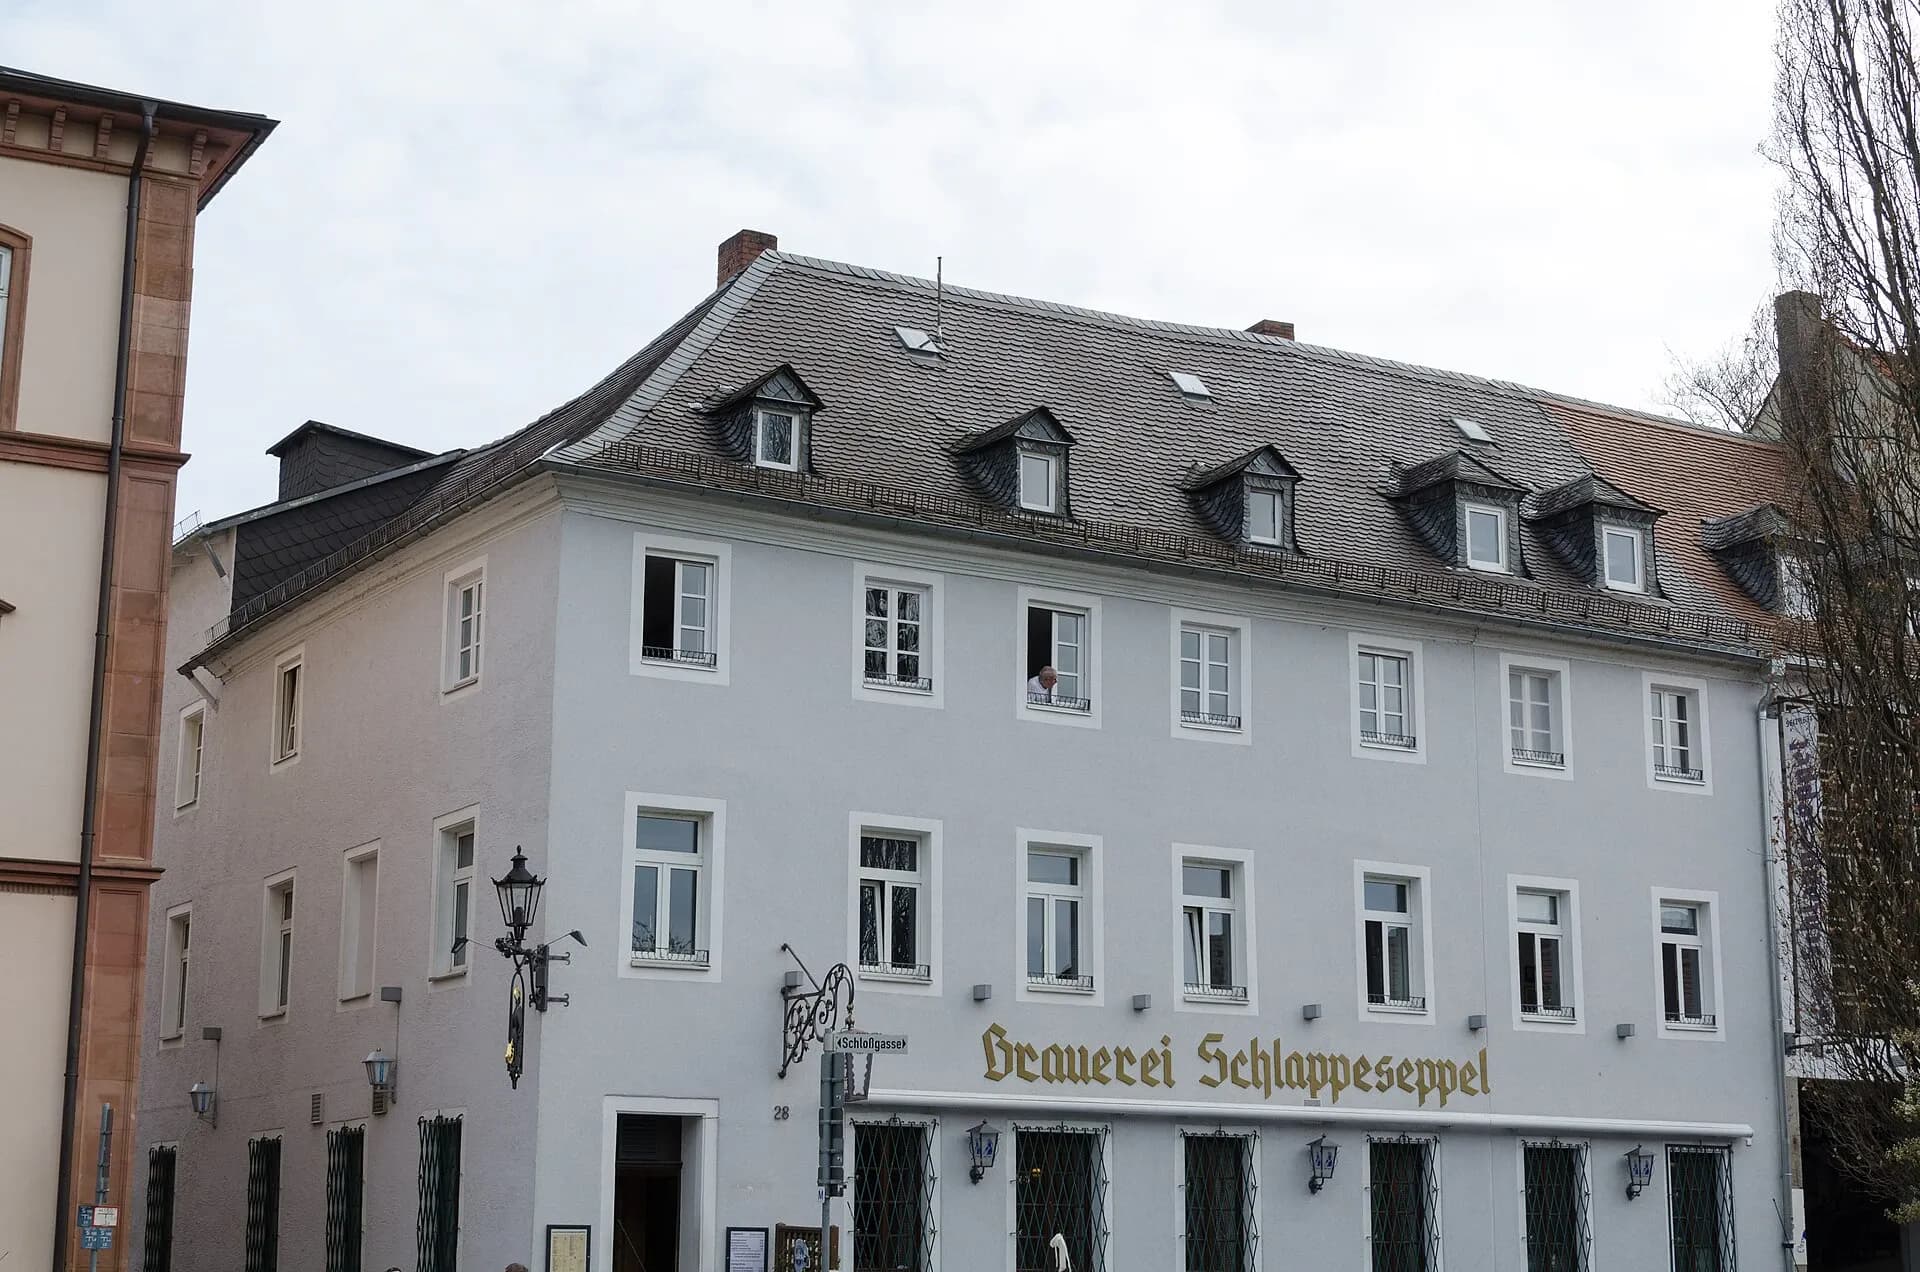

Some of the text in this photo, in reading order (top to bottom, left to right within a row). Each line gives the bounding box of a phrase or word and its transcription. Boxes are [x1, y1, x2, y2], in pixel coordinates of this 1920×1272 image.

[842, 1036, 902, 1052] Schloßgasse
[982, 1022, 1491, 1108] Brauerei Schlappeseppel
[774, 1105, 790, 1120] 28
